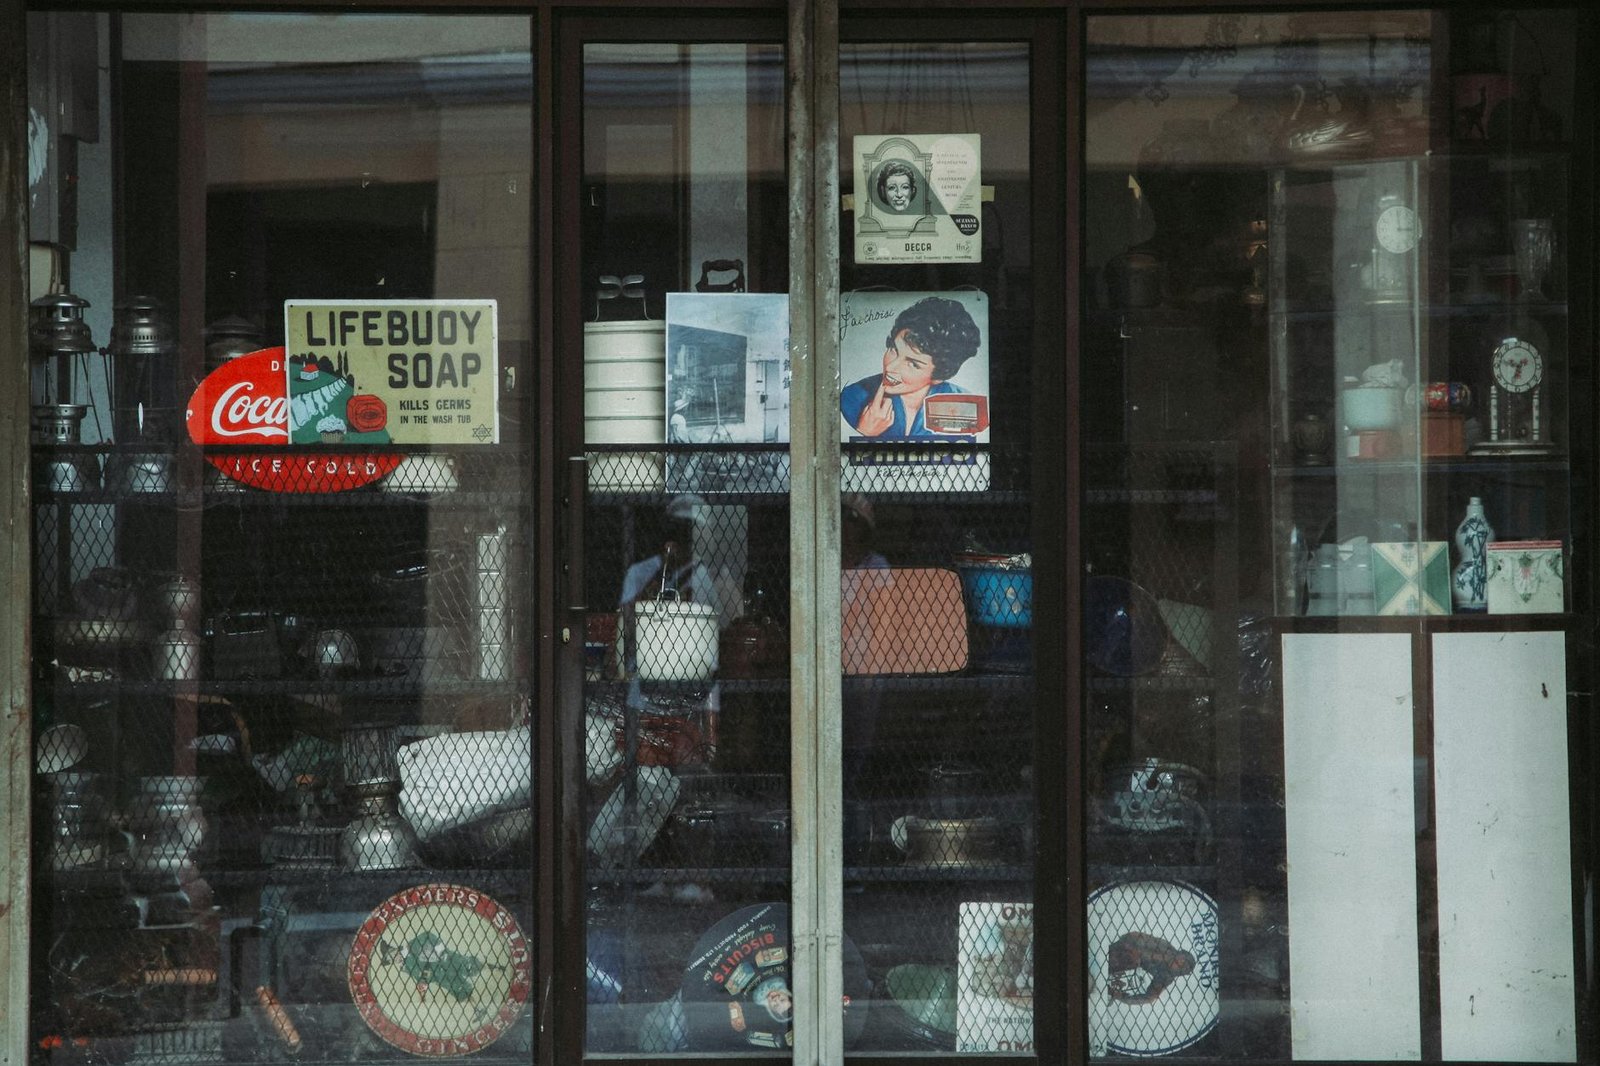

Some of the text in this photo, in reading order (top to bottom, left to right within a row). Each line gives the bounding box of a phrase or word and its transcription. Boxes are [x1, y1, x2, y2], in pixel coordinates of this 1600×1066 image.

[905, 243, 931, 251] DECCA
[306, 310, 481, 347] LIFEBUOY
[388, 353, 481, 389] SOAP
[399, 399, 471, 411] KILLS GERMS
[400, 414, 472, 424] IN THE WASH TUB
[235, 459, 376, 475] ICE COLD
[373, 887, 480, 923] PALMERS
[737, 923, 749, 933] FOOD
[714, 932, 737, 951] PRODUCTS
[713, 932, 775, 984] BISCUITS
[1190, 922, 1212, 989] BRAND
